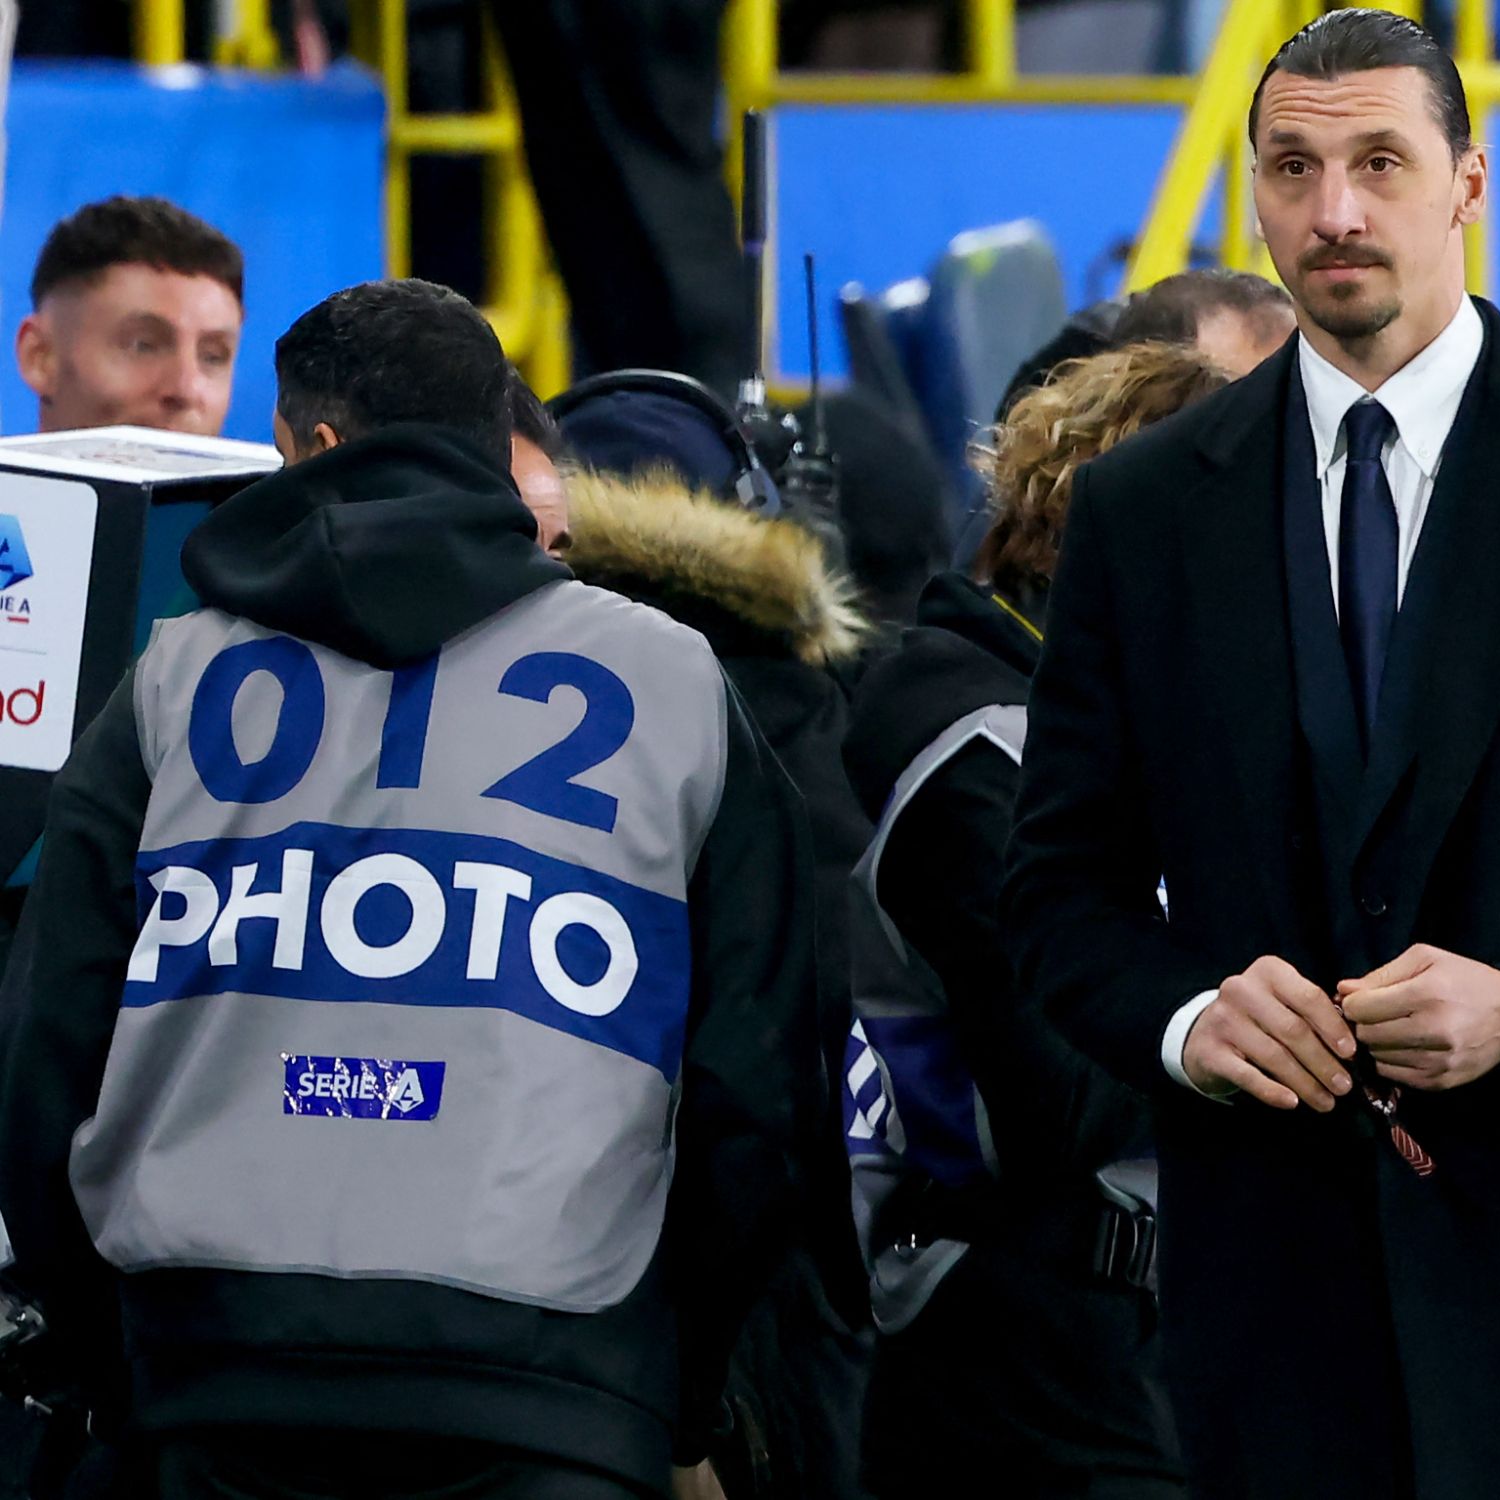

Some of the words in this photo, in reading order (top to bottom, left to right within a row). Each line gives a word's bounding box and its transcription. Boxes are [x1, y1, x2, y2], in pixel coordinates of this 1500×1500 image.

[19, 598, 31, 614] A
[189, 636, 635, 833] 012
[126, 849, 638, 1016] PHOTO
[297, 1072, 377, 1100] SERIE
